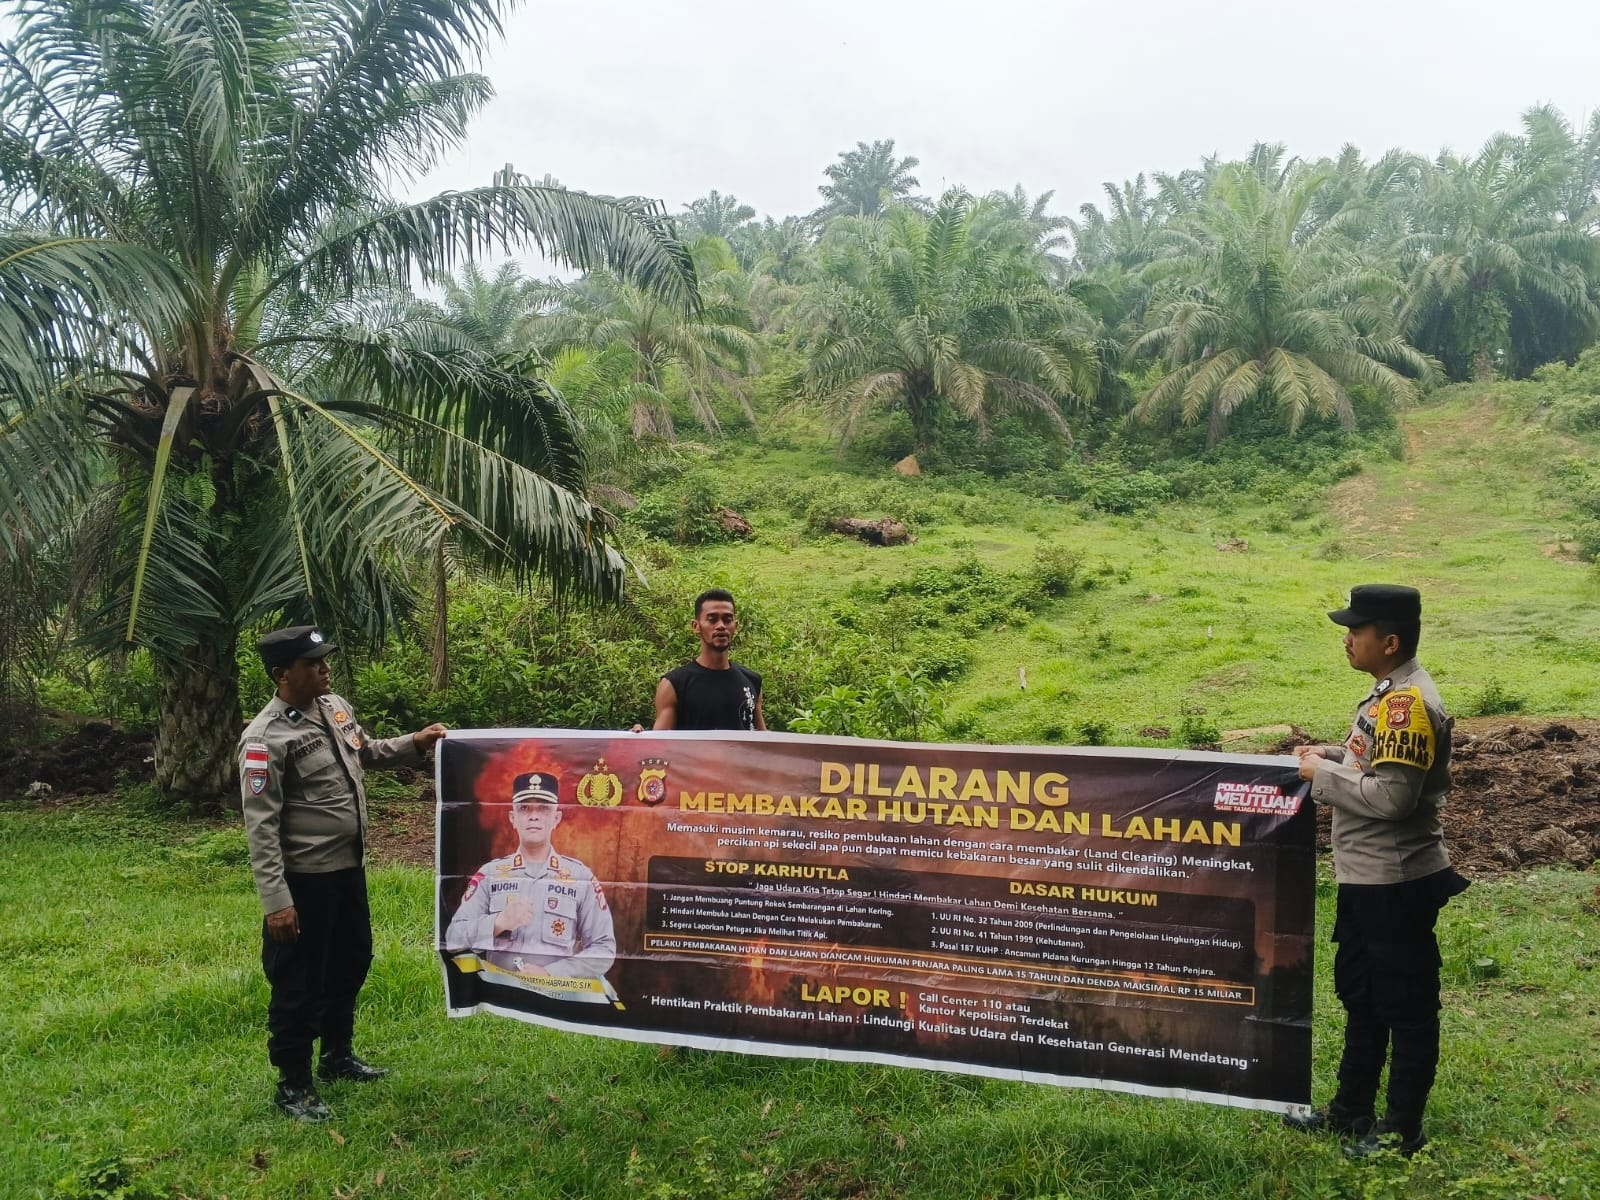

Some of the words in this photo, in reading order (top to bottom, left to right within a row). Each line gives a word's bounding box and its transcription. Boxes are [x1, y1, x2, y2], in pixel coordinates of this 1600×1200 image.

[820, 762, 1069, 807] DILARANG
[1217, 783, 1250, 793] POLDA
[1251, 784, 1278, 794] ACEH
[1214, 791, 1299, 810] MEUTUAH
[679, 791, 867, 820] MEMBAKAR
[878, 800, 999, 829] HUTAN
[1010, 807, 1090, 836] DAN
[1102, 813, 1241, 847] LAHAN
[667, 822, 719, 833] Memasuki
[721, 825, 756, 835] musim
[758, 827, 806, 839] kemarau,
[809, 830, 840, 840] resiko
[843, 832, 907, 844] pembukaan
[910, 835, 940, 846] lahan
[943, 837, 986, 852] dengan
[989, 841, 1014, 851] cara
[1016, 843, 1080, 857] membakar
[1084, 847, 1118, 860] (Land
[1121, 851, 1178, 866] Clearing)
[1182, 855, 1254, 872] Meningkat,
[717, 837, 760, 848] percikan
[763, 839, 780, 849] api
[782, 840, 817, 851] sekecil
[819, 843, 839, 854] apa
[841, 844, 862, 854] pun
[865, 844, 897, 856] dapat
[900, 847, 943, 858] memicu
[946, 850, 1006, 863] kebakaran
[1009, 853, 1041, 866] besar
[1043, 858, 1073, 870] yang
[1076, 861, 1103, 872] sulit
[1106, 862, 1190, 879] dikendalikan.
[705, 861, 750, 874] STOP
[754, 863, 849, 881] KARHUTLA
[491, 883, 518, 893] MUGHI
[548, 884, 577, 898] POLRI
[1009, 882, 1075, 899] DASAR
[1081, 887, 1158, 907] HUKUM
[670, 894, 693, 903] Jangan
[695, 895, 733, 906] Membuang
[734, 897, 763, 908] Puntung
[788, 901, 835, 912] Sembarangan
[837, 904, 843, 912] di
[845, 905, 866, 914] Lahan
[868, 907, 894, 917] Kering.
[755, 883, 774, 892] Jaga
[776, 884, 801, 893] Udara
[803, 885, 820, 894] Kita
[822, 887, 845, 897] Tetap
[847, 888, 871, 898] Segar
[879, 891, 912, 901] Hindari
[914, 894, 962, 905] Membakar
[964, 898, 992, 908] Lahan
[994, 900, 1018, 909] Demi
[1020, 903, 1069, 915] Kesehatan
[1072, 907, 1116, 919] Bersama.
[669, 921, 692, 931] Segera
[693, 922, 724, 932] Laporkan
[726, 925, 752, 935] Petugas
[754, 926, 767, 934] Jika
[768, 927, 795, 937] Melihat
[797, 930, 812, 938] Titik
[814, 931, 828, 940] Api.
[670, 907, 694, 916] Hindari
[696, 909, 729, 918] Membuka
[731, 911, 751, 920] Lahan
[752, 913, 779, 922] Dengan
[780, 914, 796, 922] Cara
[797, 915, 835, 925] Melakukan
[837, 918, 883, 929] Pembakaran.
[939, 913, 952, 921] UU
[963, 915, 977, 923] No.
[978, 916, 988, 924] 32
[990, 917, 1013, 926] Tahun
[1014, 920, 1033, 929] 2009
[1035, 922, 1091, 935] (Perlindungan
[1092, 926, 1108, 935] dan
[1110, 929, 1159, 941] Pengelolaan
[1161, 934, 1210, 946] Lingkungan
[1212, 938, 1243, 950] Hidup).
[939, 927, 952, 935] UU
[953, 928, 961, 936] RI
[963, 929, 977, 938] No.
[978, 931, 987, 939] 41
[990, 931, 1013, 941] Tahun
[1015, 934, 1033, 943] 1999
[1035, 936, 1086, 949] (Kehutanan).
[650, 940, 681, 948] PELAKU
[683, 941, 737, 953] PEMBAKARAN
[739, 945, 767, 955] HUTAN
[769, 947, 788, 956] DAN
[789, 950, 818, 959] LAHAN
[820, 952, 862, 962] DIANCAM
[864, 955, 910, 966] HUKUMAN
[912, 959, 950, 970] PENJARA
[952, 964, 985, 974] PALING
[987, 968, 1013, 978] LAMA
[1016, 970, 1026, 978] 15
[1029, 971, 1061, 983] TAHUN
[1063, 975, 1085, 985] DAN
[1087, 977, 1120, 988] DENDA
[1123, 981, 1175, 994] MAKSIMAL
[1178, 986, 1190, 995] RP
[1194, 988, 1204, 996] 15
[1207, 989, 1242, 1000] MILIAR
[931, 941, 938, 949] 3.
[939, 941, 958, 951] Pasal
[960, 943, 974, 952] 187
[976, 945, 999, 954] KUHP
[1004, 948, 1040, 959] Ancaman
[1042, 951, 1069, 961] Pidana
[1071, 954, 1110, 965] Kurungan
[1112, 959, 1141, 969] Hingga
[1156, 963, 1181, 973] Tahun
[1183, 966, 1216, 977] Penjara.
[801, 983, 890, 1008] LAPOR
[899, 991, 906, 1009] !
[919, 992, 938, 1002] Call
[941, 995, 978, 1007] Center
[982, 999, 1002, 1009] 110
[1004, 1003, 1031, 1013] atau
[919, 1004, 955, 1016] Kantor
[959, 1008, 1017, 1023] Kepolisian
[1020, 1015, 1069, 1030] Terdekat
[651, 996, 701, 1009] Hentikan
[704, 1000, 743, 1013] Praktik
[745, 1004, 815, 1020] Pembakaran
[818, 1011, 852, 1023] Lahan
[863, 1015, 915, 1032] Lindungi
[919, 1021, 966, 1036] Kualitas
[970, 1027, 1006, 1040] Udara
[1010, 1031, 1034, 1044] dan
[1038, 1035, 1104, 1051] Kesehatan
[1108, 1042, 1165, 1058] Generasi
[1169, 1048, 1248, 1070] Mendatang
